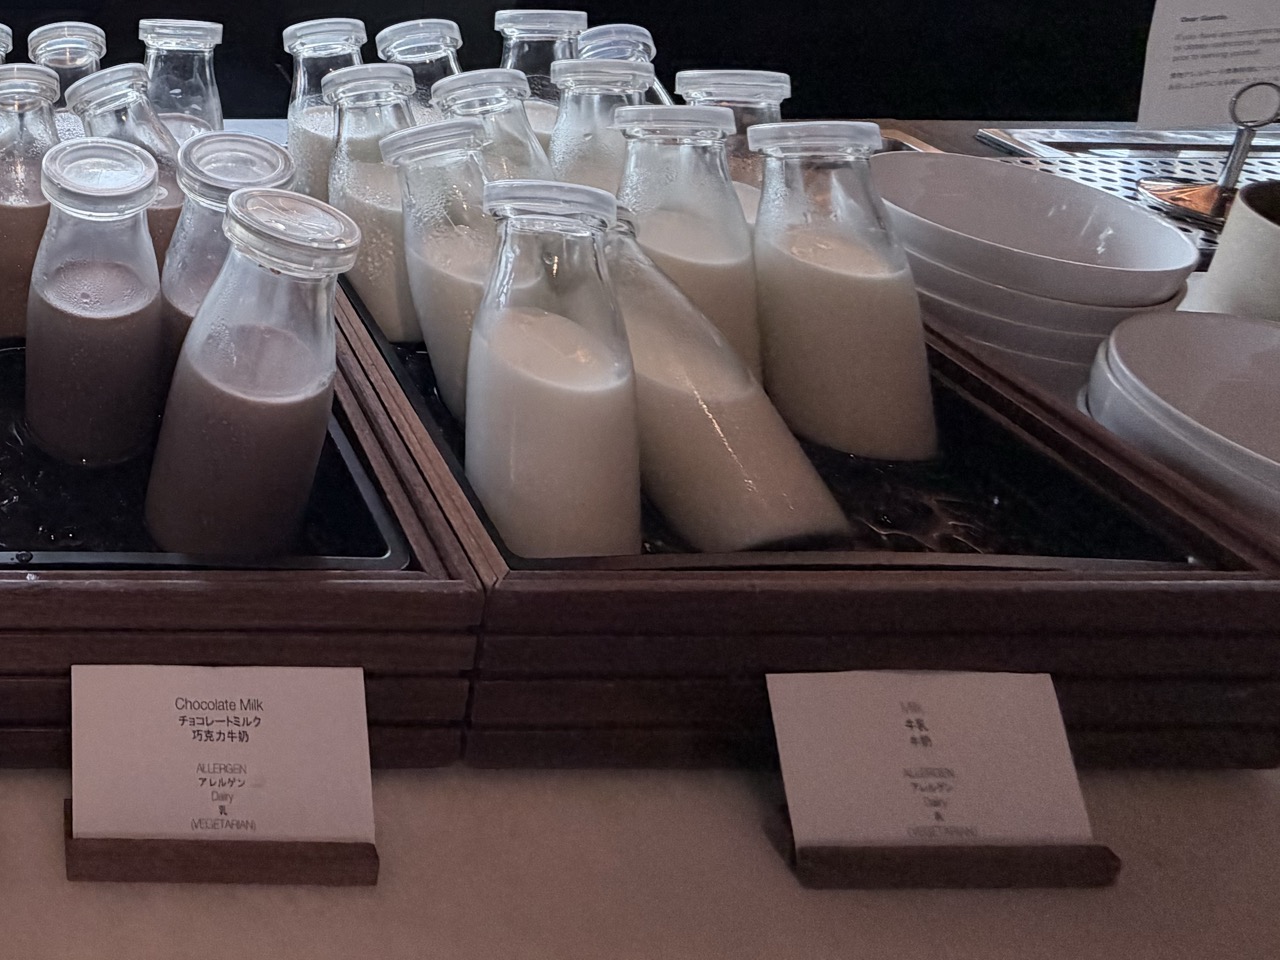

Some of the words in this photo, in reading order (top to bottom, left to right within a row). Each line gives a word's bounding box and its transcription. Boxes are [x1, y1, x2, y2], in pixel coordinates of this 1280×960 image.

[174, 697, 236, 712] Chocolate
[239, 698, 264, 712] Milk
[178, 715, 261, 728] チョコレートミルク
[192, 730, 250, 742] 巧克力牛奶
[196, 763, 248, 775] ALLERGEN
[198, 777, 246, 788] アレルゲン
[211, 790, 234, 804] Dairy
